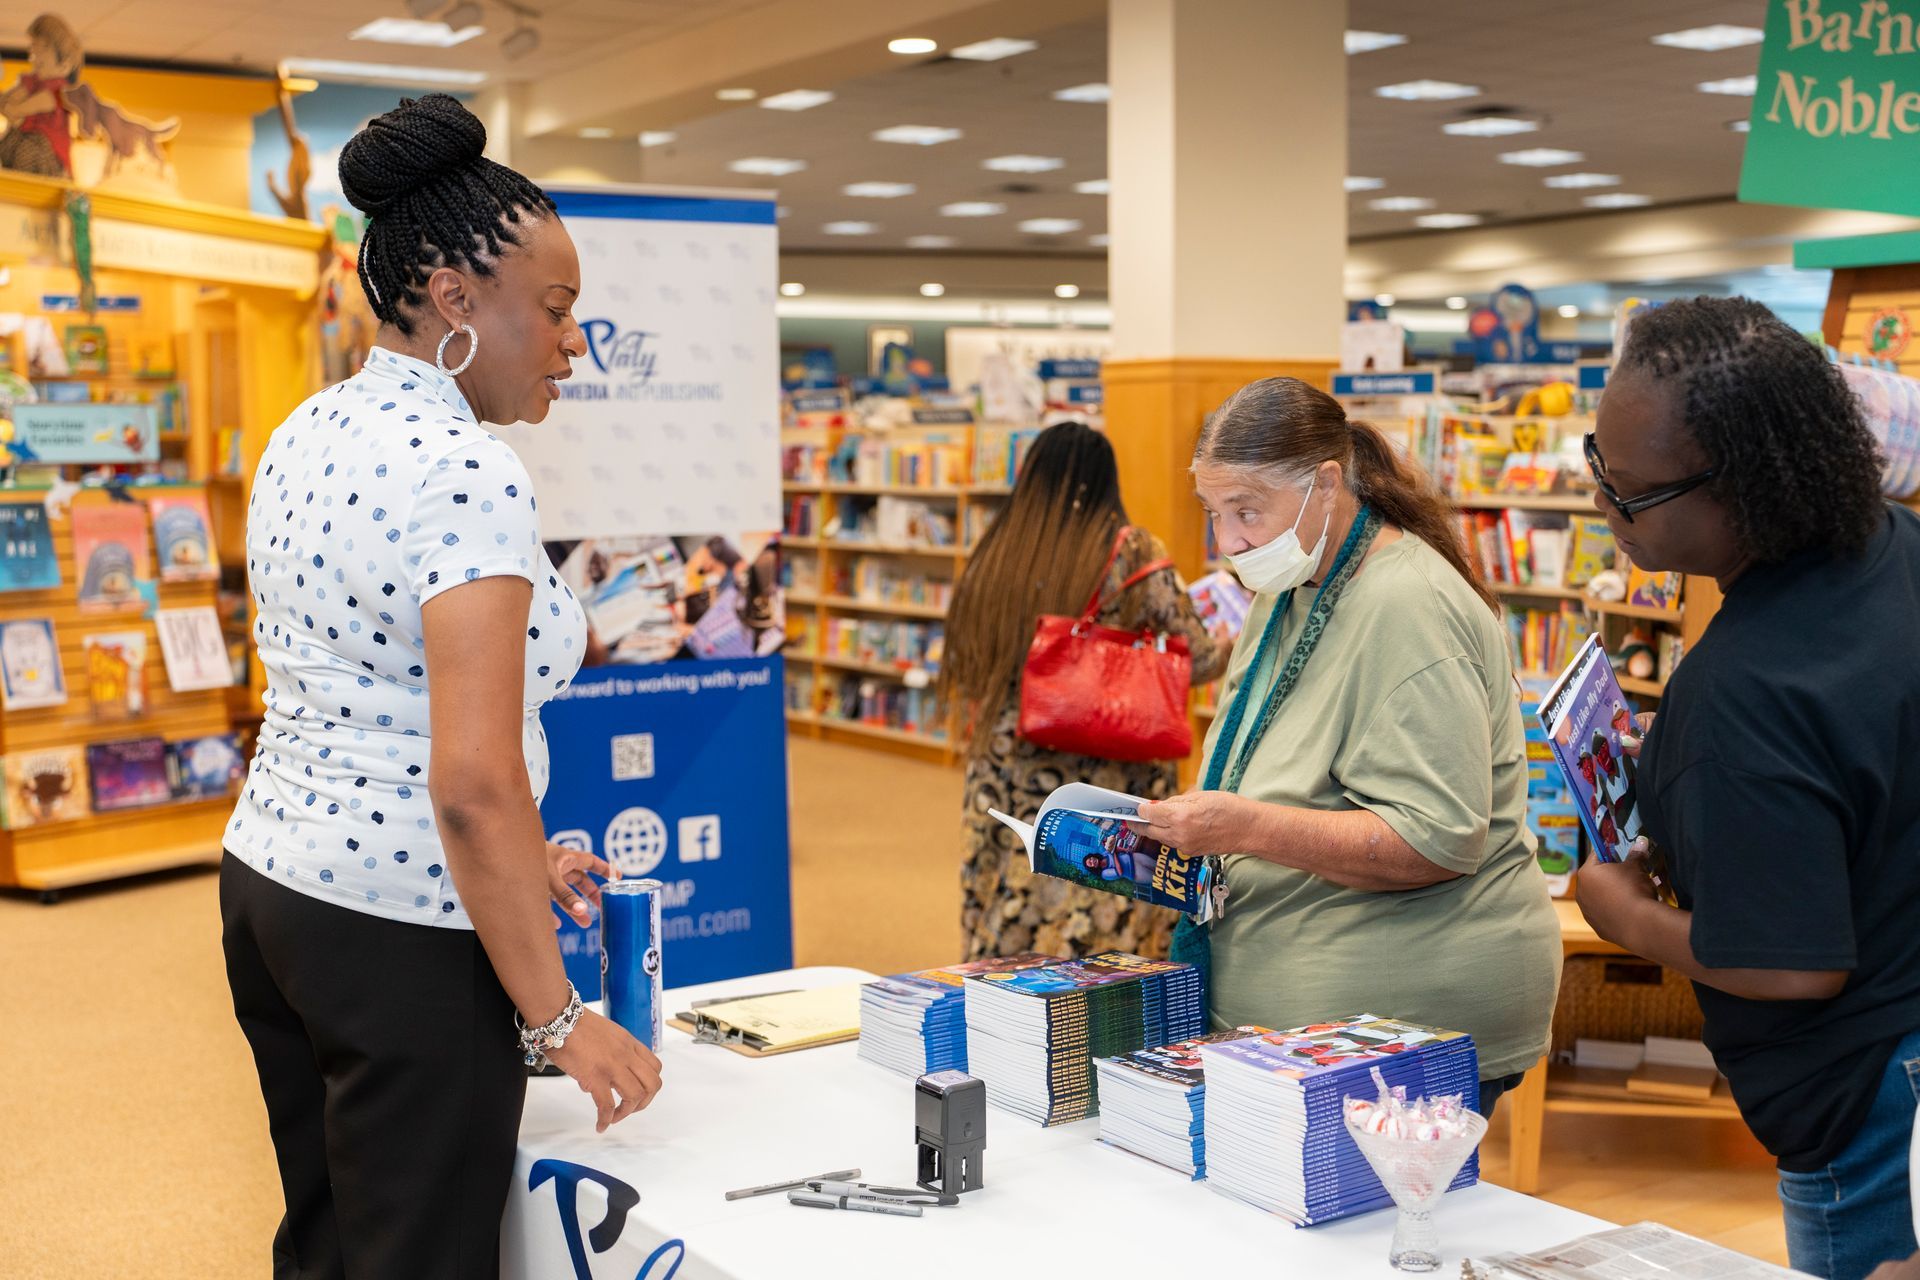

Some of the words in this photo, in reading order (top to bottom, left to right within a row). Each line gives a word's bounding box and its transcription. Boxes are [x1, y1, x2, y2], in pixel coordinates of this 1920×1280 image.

[1784, 0, 1920, 55] Barn
[1765, 69, 1920, 139] Noble
[616, 678, 634, 697] to
[635, 673, 699, 694] working
[701, 668, 736, 688] with
[737, 666, 771, 690] you!
[1567, 730, 1581, 749] Just
[1577, 705, 1591, 726] Like
[1586, 689, 1599, 711] My
[1596, 667, 1609, 692] Dad
